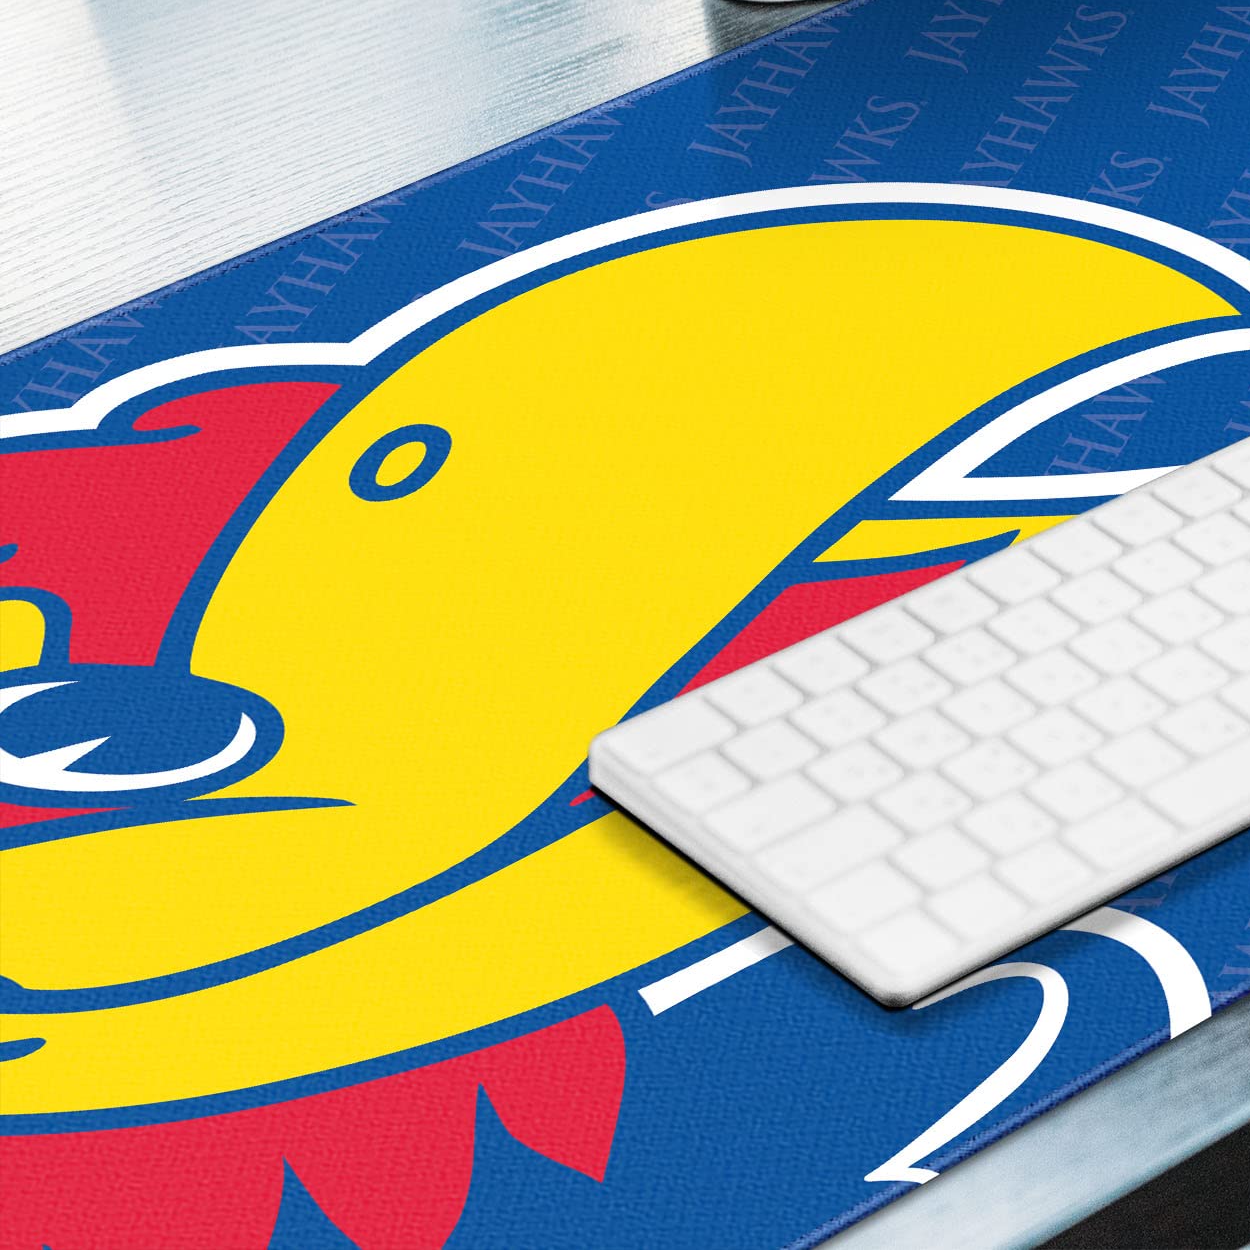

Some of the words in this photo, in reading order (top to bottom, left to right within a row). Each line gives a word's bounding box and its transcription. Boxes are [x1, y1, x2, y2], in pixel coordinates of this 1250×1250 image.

[687, 9, 853, 168] JAYHA
[949, 4, 1127, 188] YHAWKS
[456, 100, 636, 257] JAYHA
